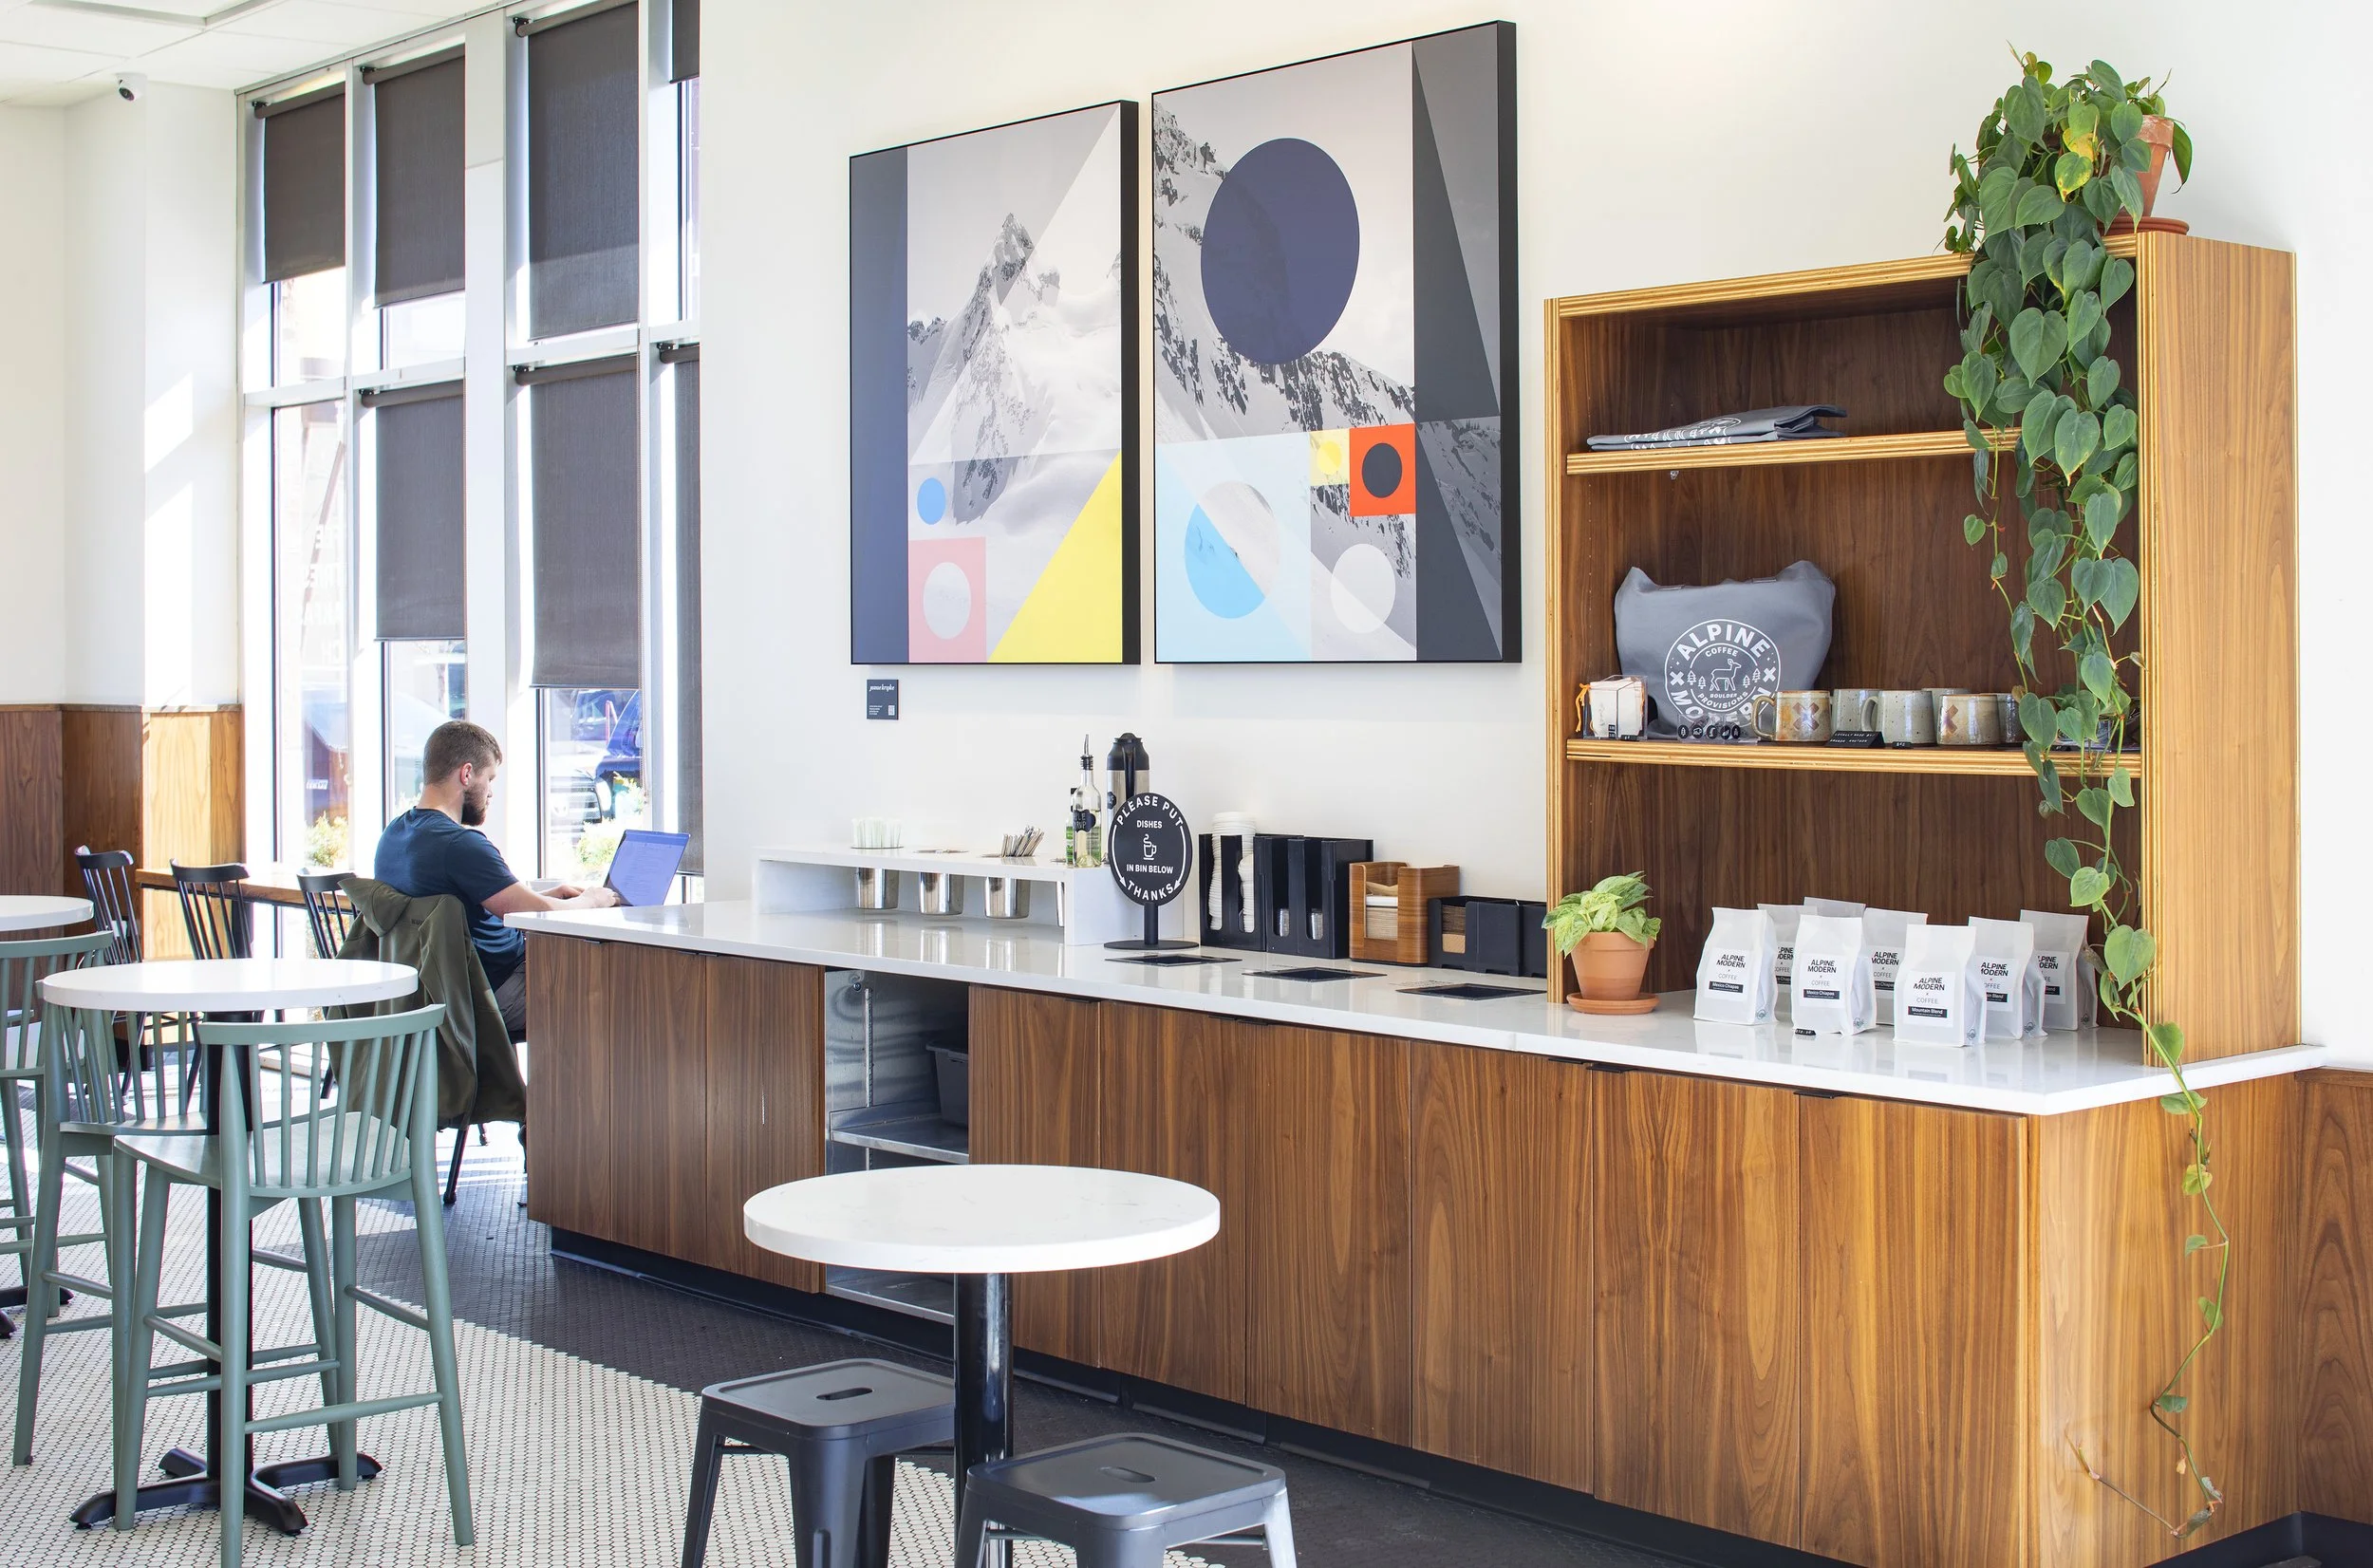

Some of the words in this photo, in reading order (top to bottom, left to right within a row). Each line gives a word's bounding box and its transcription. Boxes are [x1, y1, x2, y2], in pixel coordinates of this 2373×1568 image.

[1676, 624, 1770, 661] ALPINE
[1705, 646, 1738, 657] COFFEE
[1697, 692, 1748, 709] PROVISIONS
[1117, 795, 1158, 825] PLEASE
[1162, 802, 1183, 826] PUT
[1137, 820, 1162, 828] DISHES
[1126, 864, 1134, 872] IN
[1135, 865, 1147, 873] BIN
[1149, 865, 1174, 874] BELOW
[1128, 880, 1174, 900] THANKS
[1721, 954, 1745, 962] ALPINE
